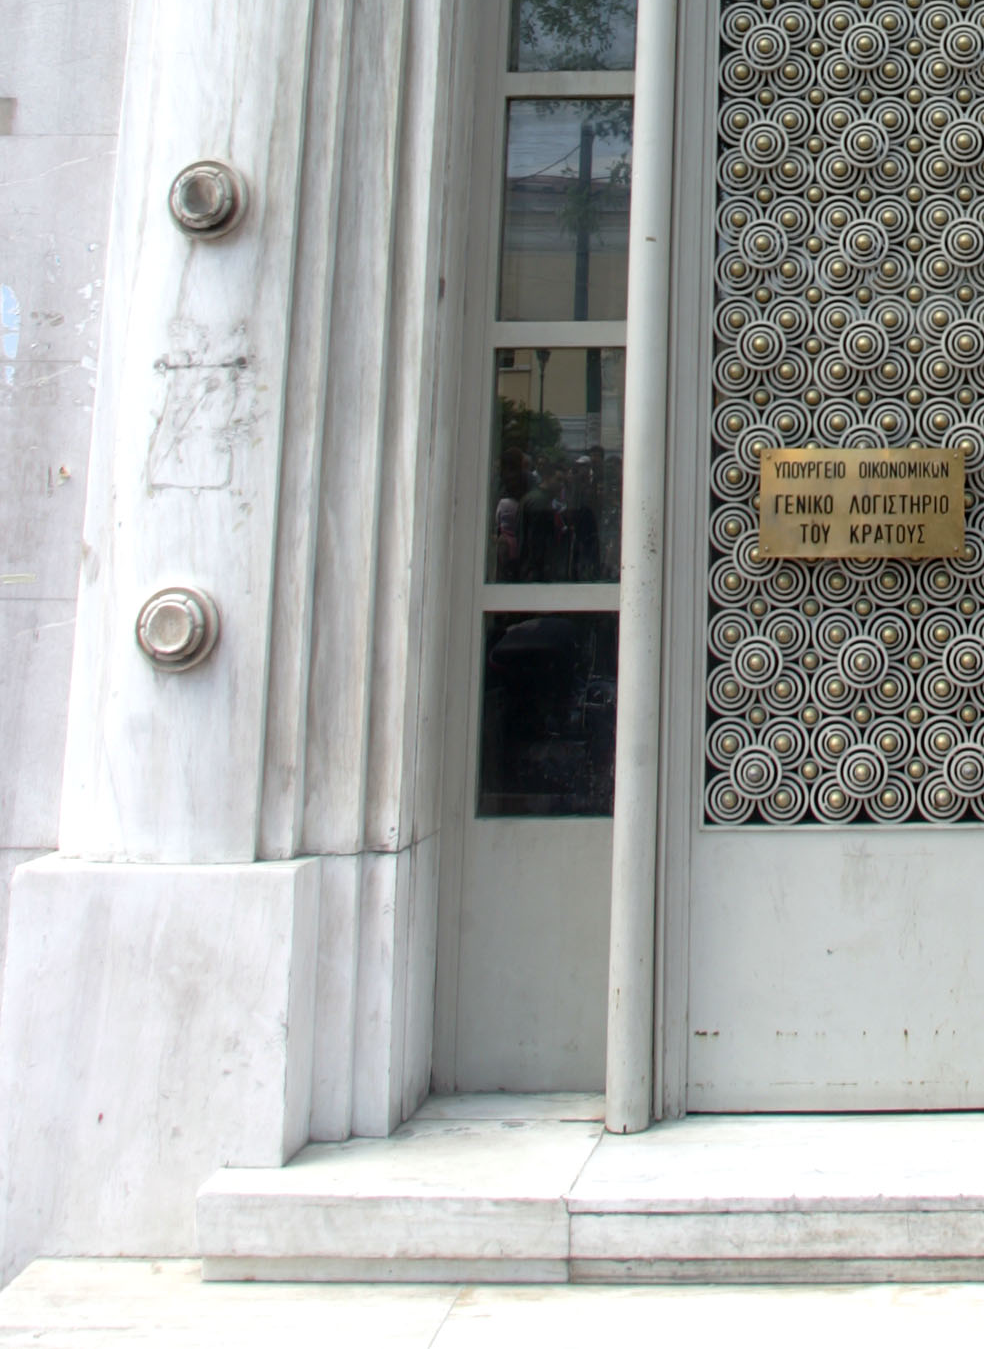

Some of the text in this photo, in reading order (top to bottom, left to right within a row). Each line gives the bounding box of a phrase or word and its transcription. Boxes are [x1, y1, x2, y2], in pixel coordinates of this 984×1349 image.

[775, 461, 949, 479] ΥΠΟΥΡΓΕΙΟ ΟΙΚΟΝΟΜΙΚΩΝ
[775, 495, 949, 515] ΓΕΝΙΚΟ ΛΟΓΙΣΤΗΡΙΟ
[800, 524, 925, 544] ΤΟΥ ΚΡΑΤΟΥΣ
